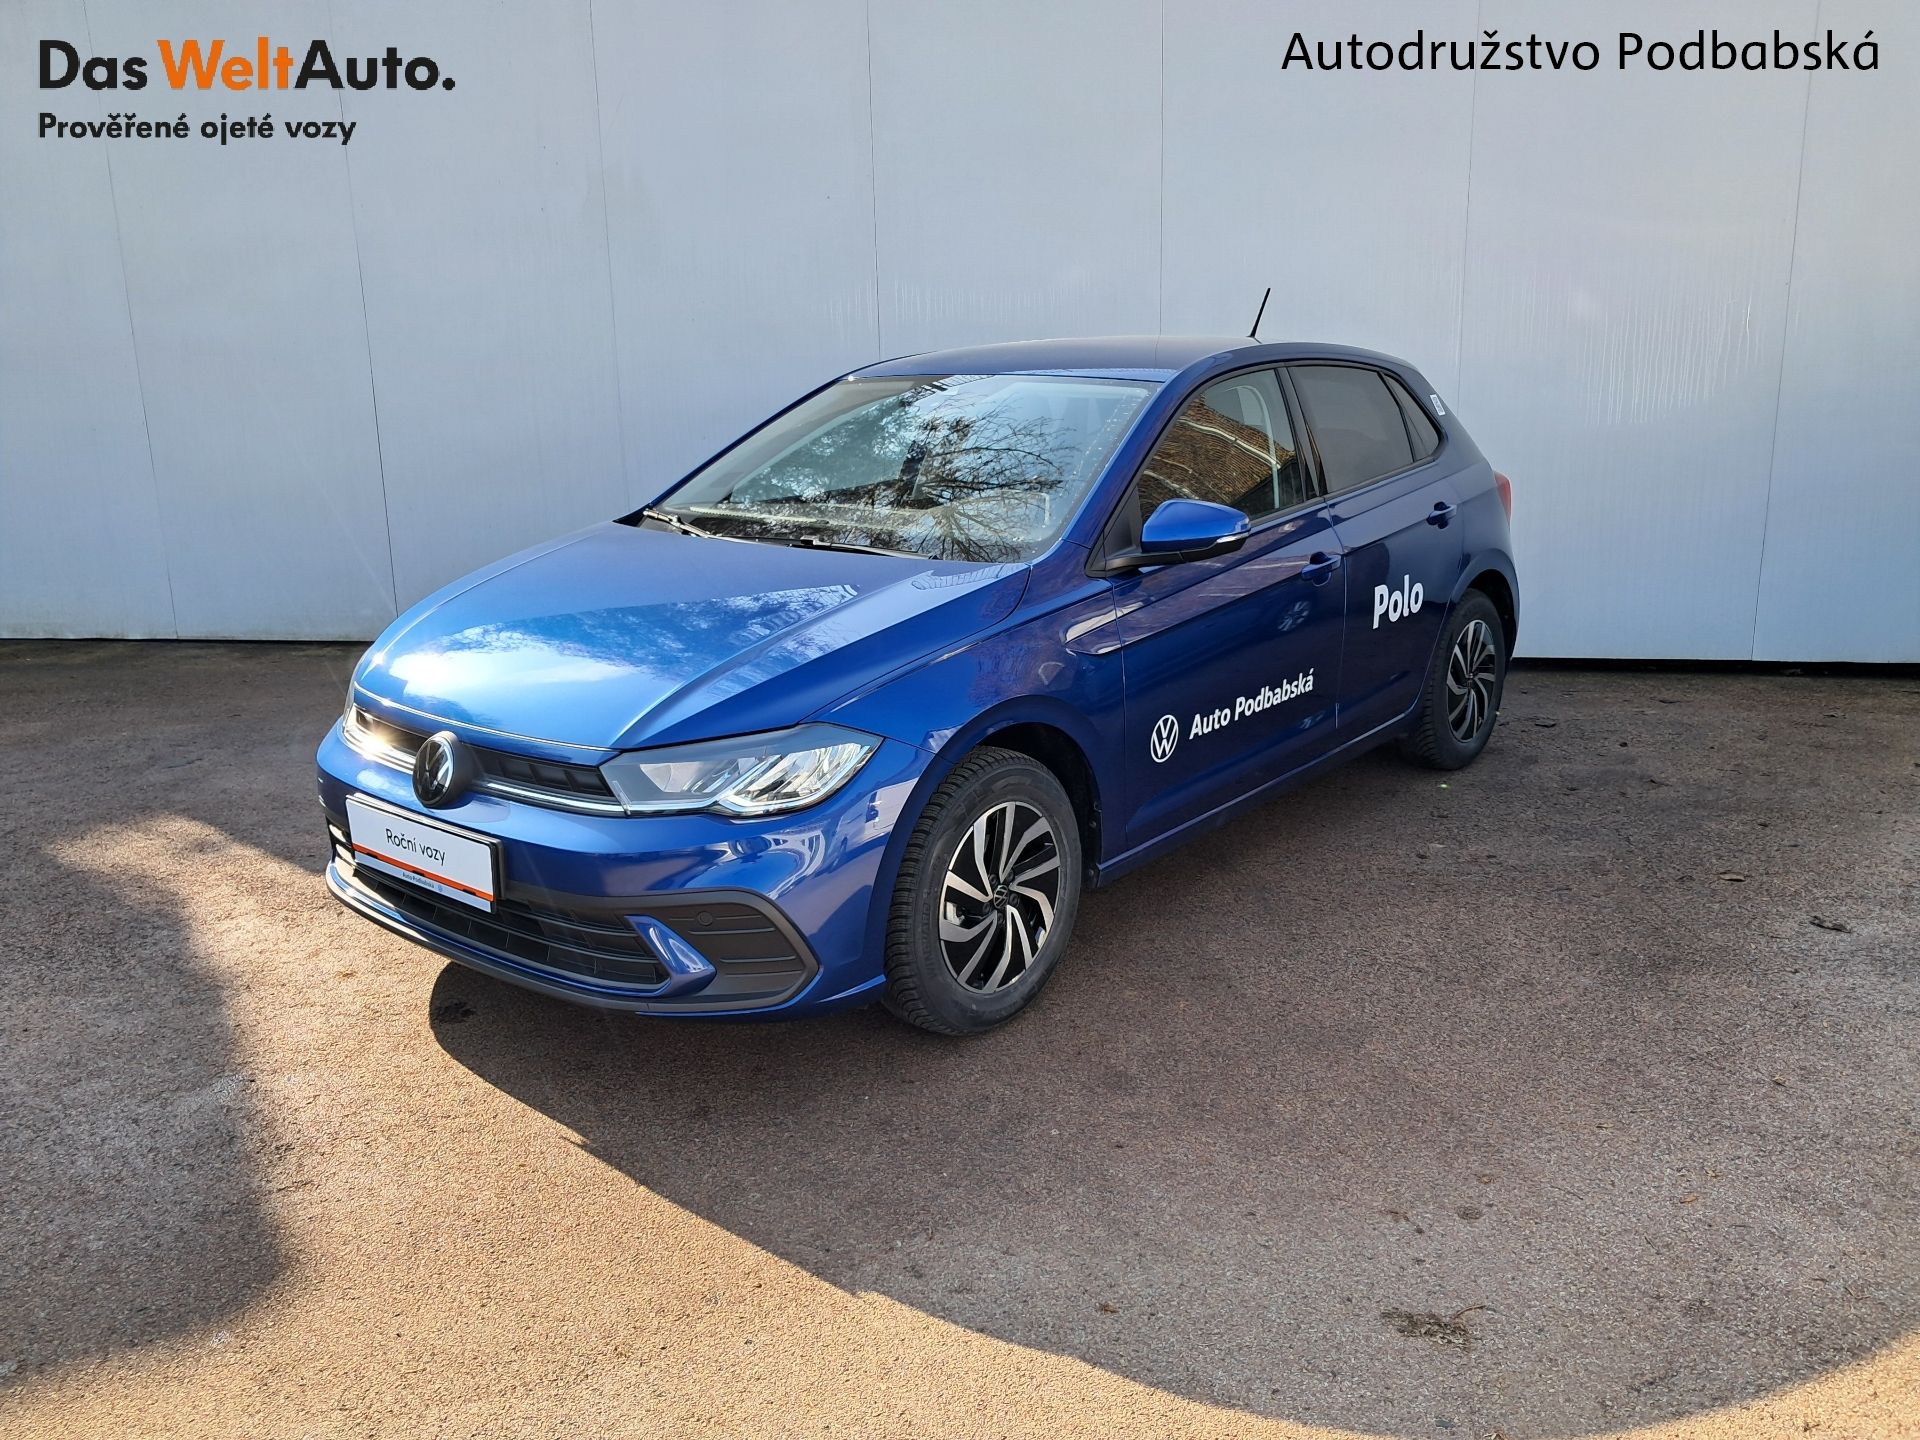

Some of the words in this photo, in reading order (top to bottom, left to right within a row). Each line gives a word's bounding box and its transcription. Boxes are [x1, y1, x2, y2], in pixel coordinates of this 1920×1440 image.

[1372, 574, 1424, 630] Polo
[1189, 708, 1231, 740] Auto
[1234, 667, 1314, 721] Podbabská
[385, 828, 417, 853] Roční
[418, 842, 445, 866] vozy
